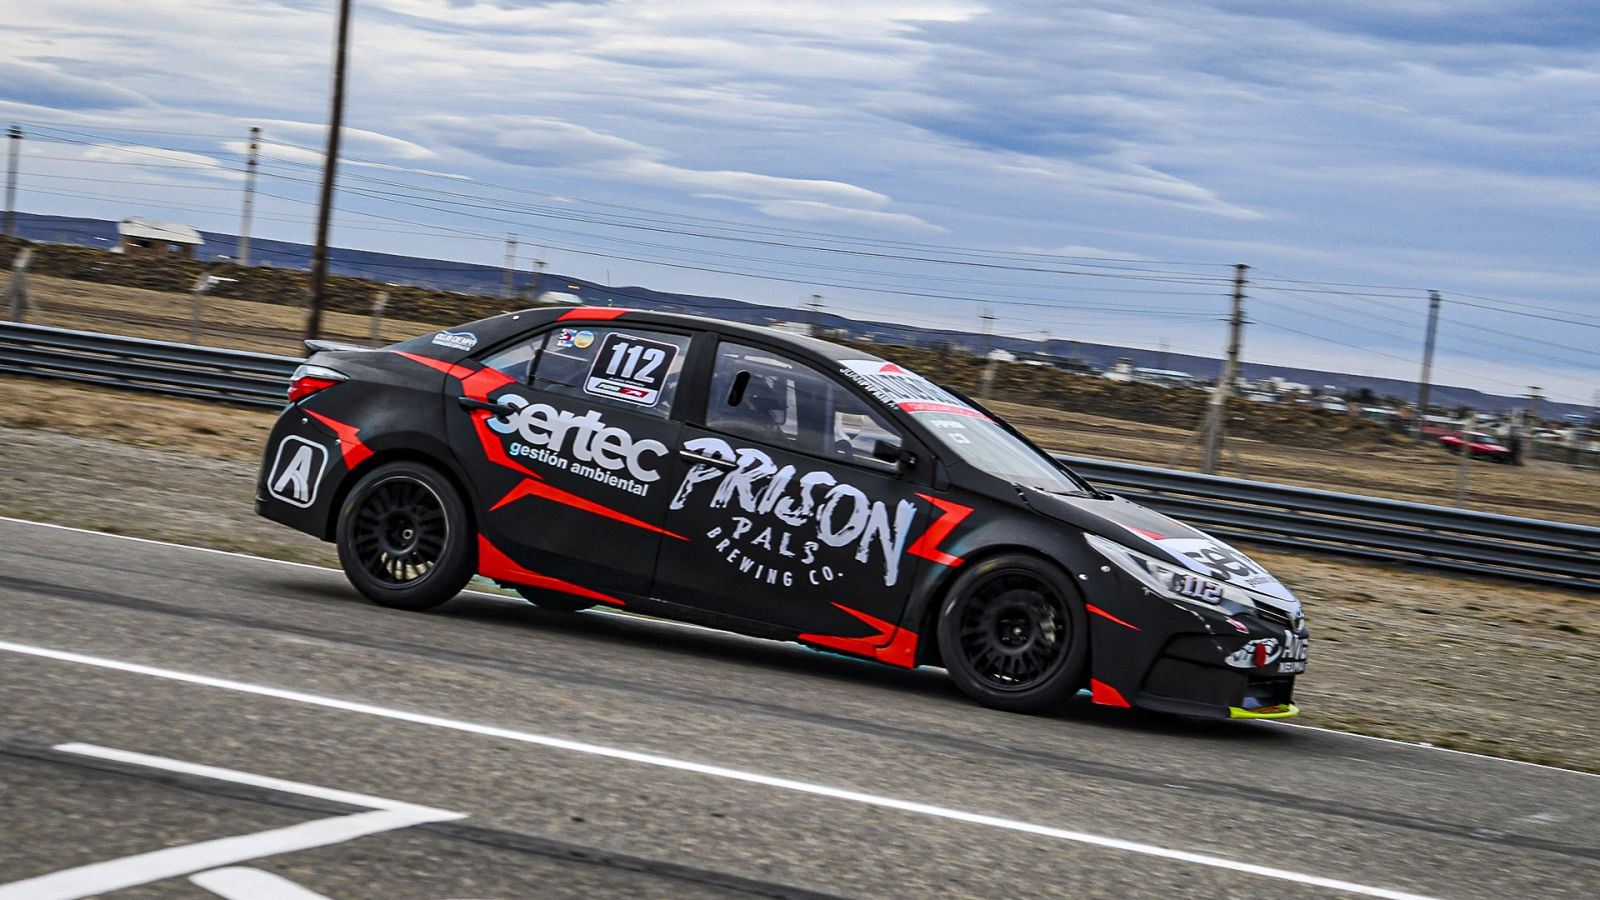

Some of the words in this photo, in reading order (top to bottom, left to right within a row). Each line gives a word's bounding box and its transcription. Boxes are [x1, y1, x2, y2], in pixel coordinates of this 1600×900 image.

[606, 342, 665, 384] 112
[486, 394, 669, 482] sertec
[509, 442, 567, 470] gestión
[570, 461, 650, 497] ambiental
[670, 437, 917, 587] PRISON
[706, 526, 794, 588] BREWING
[731, 517, 820, 565] PALS
[1179, 574, 1224, 605] 112
